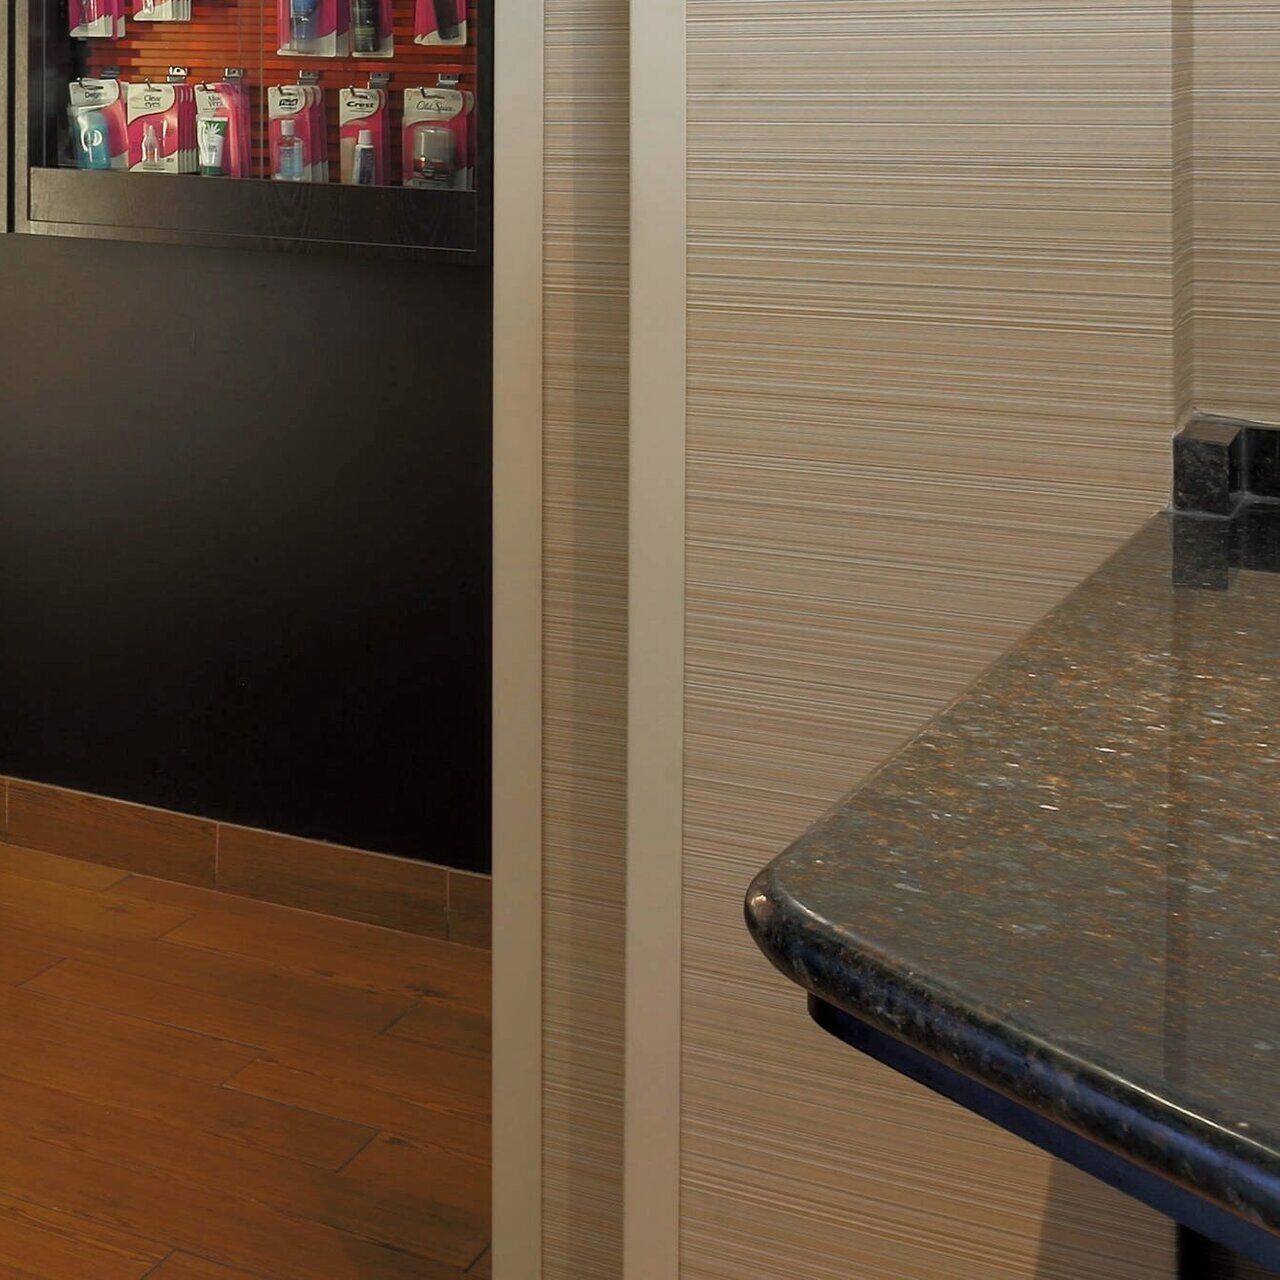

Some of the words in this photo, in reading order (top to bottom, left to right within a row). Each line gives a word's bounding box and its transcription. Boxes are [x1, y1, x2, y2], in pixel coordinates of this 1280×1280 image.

[143, 95, 161, 103] Clear
[346, 101, 374, 109] Crest
[416, 101, 433, 112] Old
[434, 102, 454, 113] Spice
